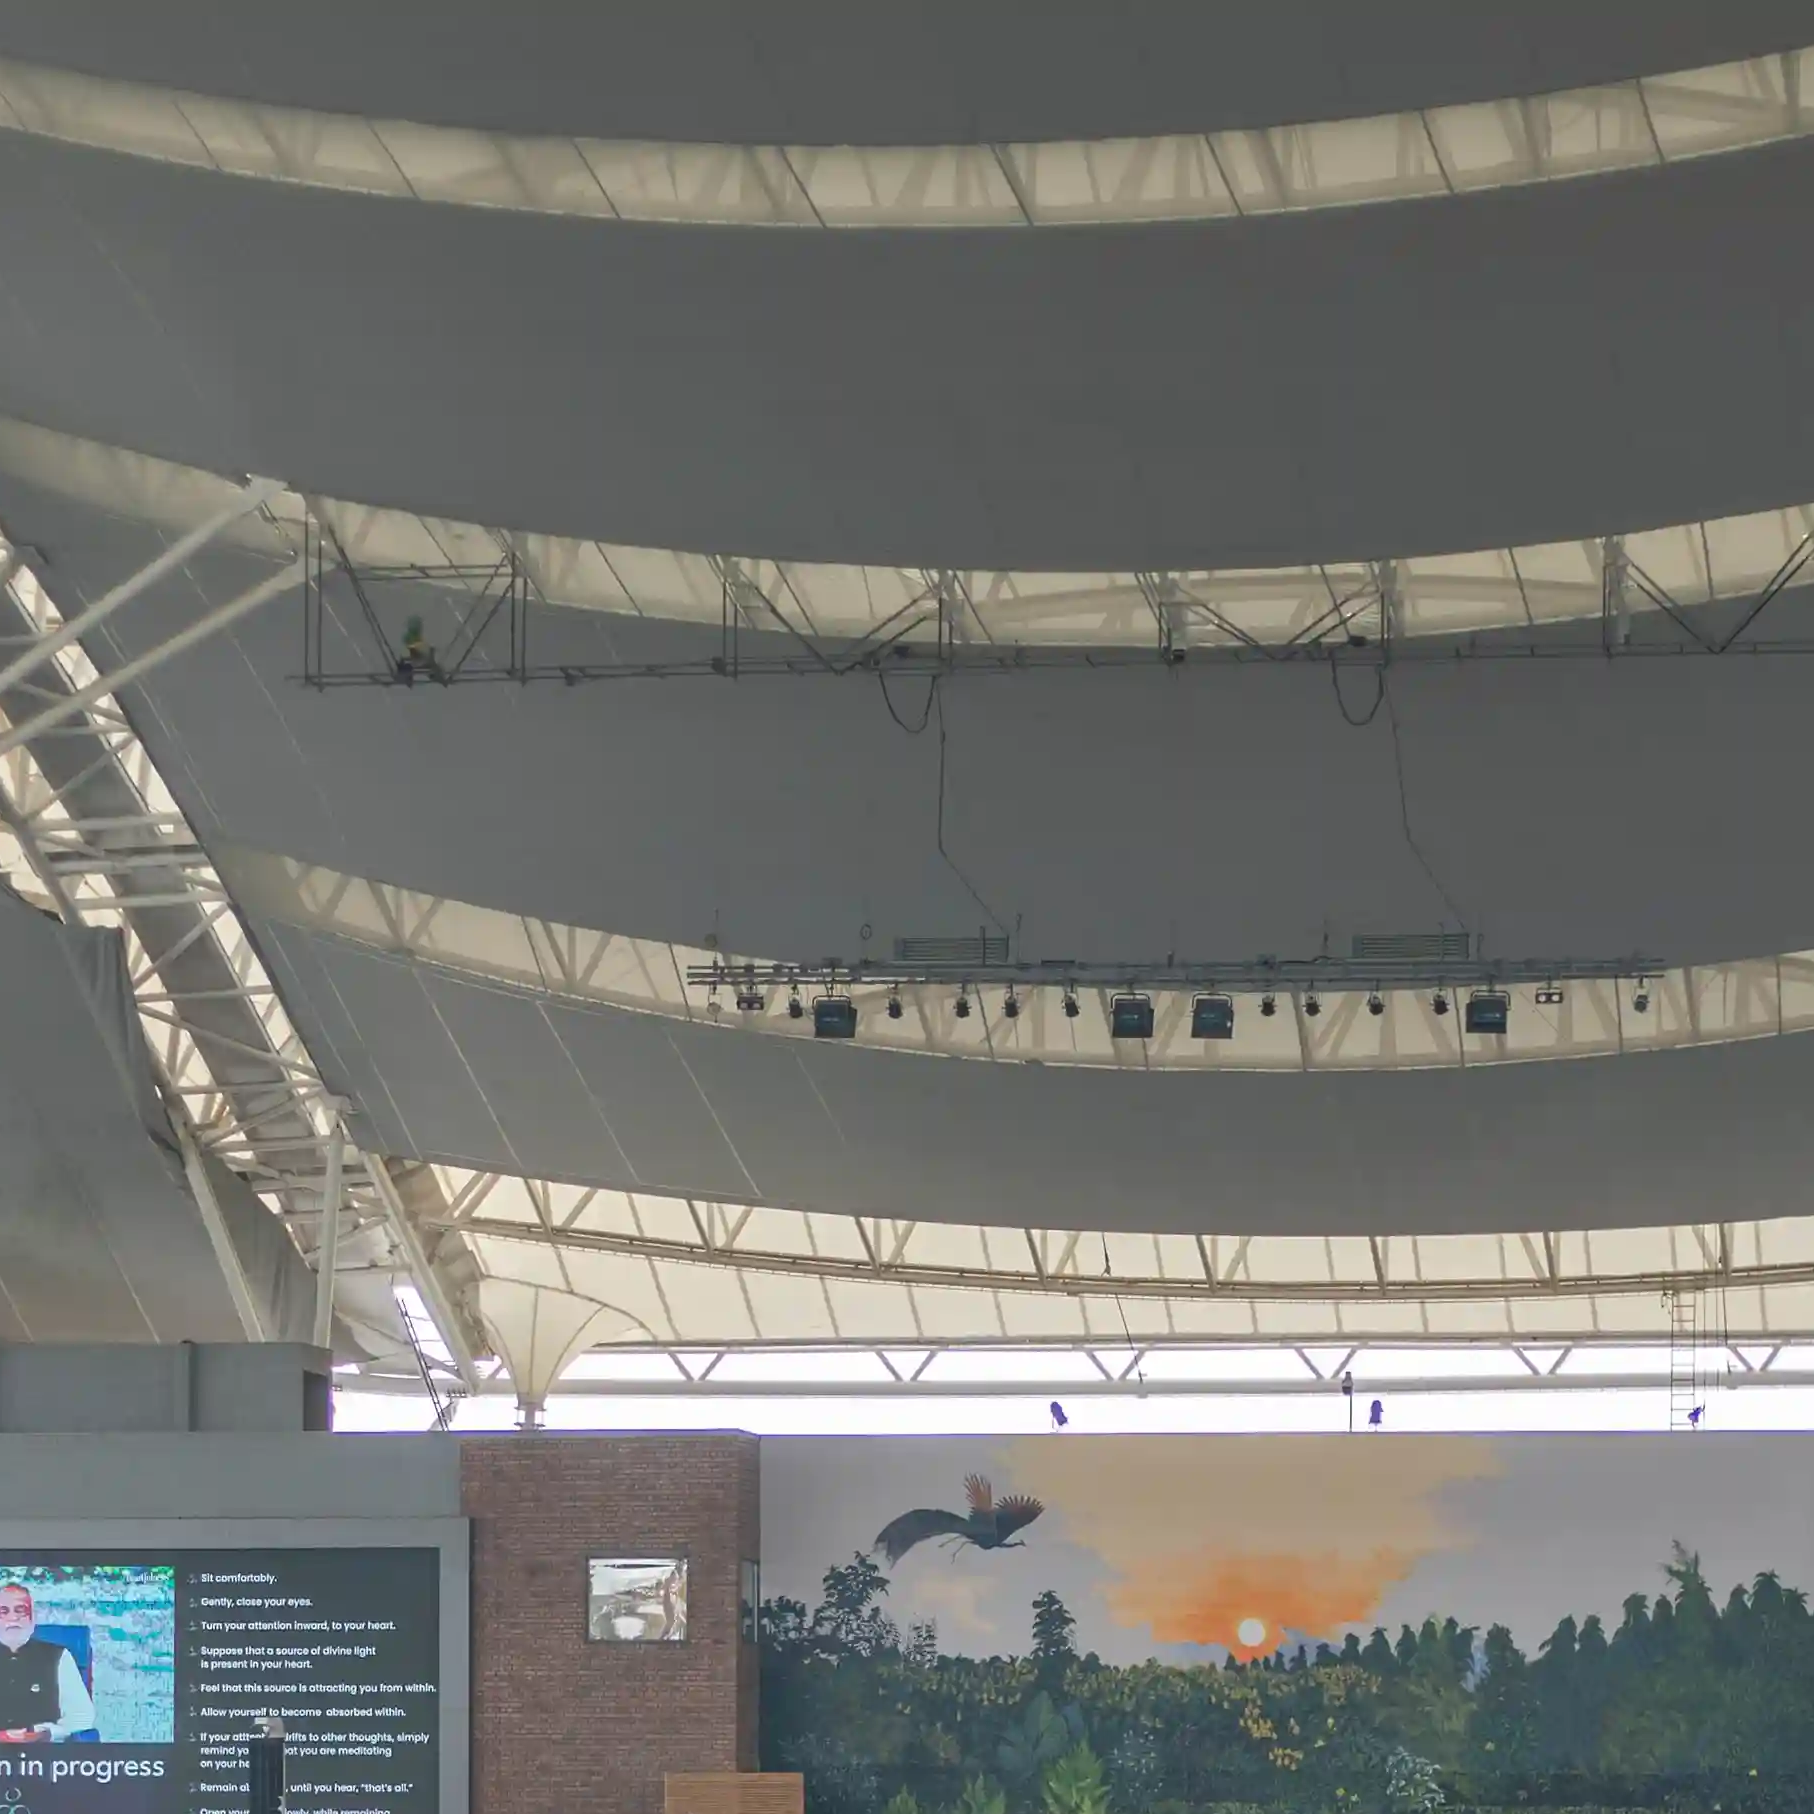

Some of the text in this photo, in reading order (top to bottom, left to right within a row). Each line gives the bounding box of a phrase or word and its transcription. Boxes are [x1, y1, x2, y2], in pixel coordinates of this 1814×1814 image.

[201, 1573, 277, 1585] Sit comfortably.
[201, 1597, 313, 1609] Gently, close your eyes.
[201, 1620, 396, 1632] Turn your attention inward, to your heart.
[201, 1645, 243, 1658] Suppose
[245, 1645, 266, 1655] that
[310, 1645, 321, 1655] of
[322, 1645, 352, 1655] divine
[354, 1645, 376, 1658] light
[201, 1659, 313, 1671] is present in your heart.
[201, 1683, 220, 1692] Feel
[222, 1683, 243, 1692] that
[244, 1683, 262, 1692] this
[299, 1683, 308, 1692] is
[309, 1683, 357, 1695] attracting
[359, 1685, 378, 1695] you
[380, 1683, 403, 1692] from
[404, 1683, 437, 1692] within.
[200, 1707, 406, 1719] Allow yourself to become absorbed within.
[200, 1732, 207, 1742] If
[208, 1734, 231, 1744] your
[232, 1732, 266, 1742] atttent
[308, 1732, 319, 1742] to
[321, 1732, 347, 1742] other
[349, 1732, 395, 1744] thoughts,
[397, 1732, 430, 1744] simply
[200, 1746, 235, 1756] remind
[299, 1748, 318, 1758] you
[338, 1746, 392, 1758] meditating
[19, 1751, 43, 1777] in
[52, 1759, 164, 1784] progress
[215, 1761, 237, 1771] your
[200, 1783, 238, 1793] Remain
[290, 1783, 312, 1793] until
[314, 1785, 332, 1795] you
[334, 1783, 359, 1794] hear,
[360, 1783, 392, 1793] "that's
[394, 1783, 413, 1793] all."
